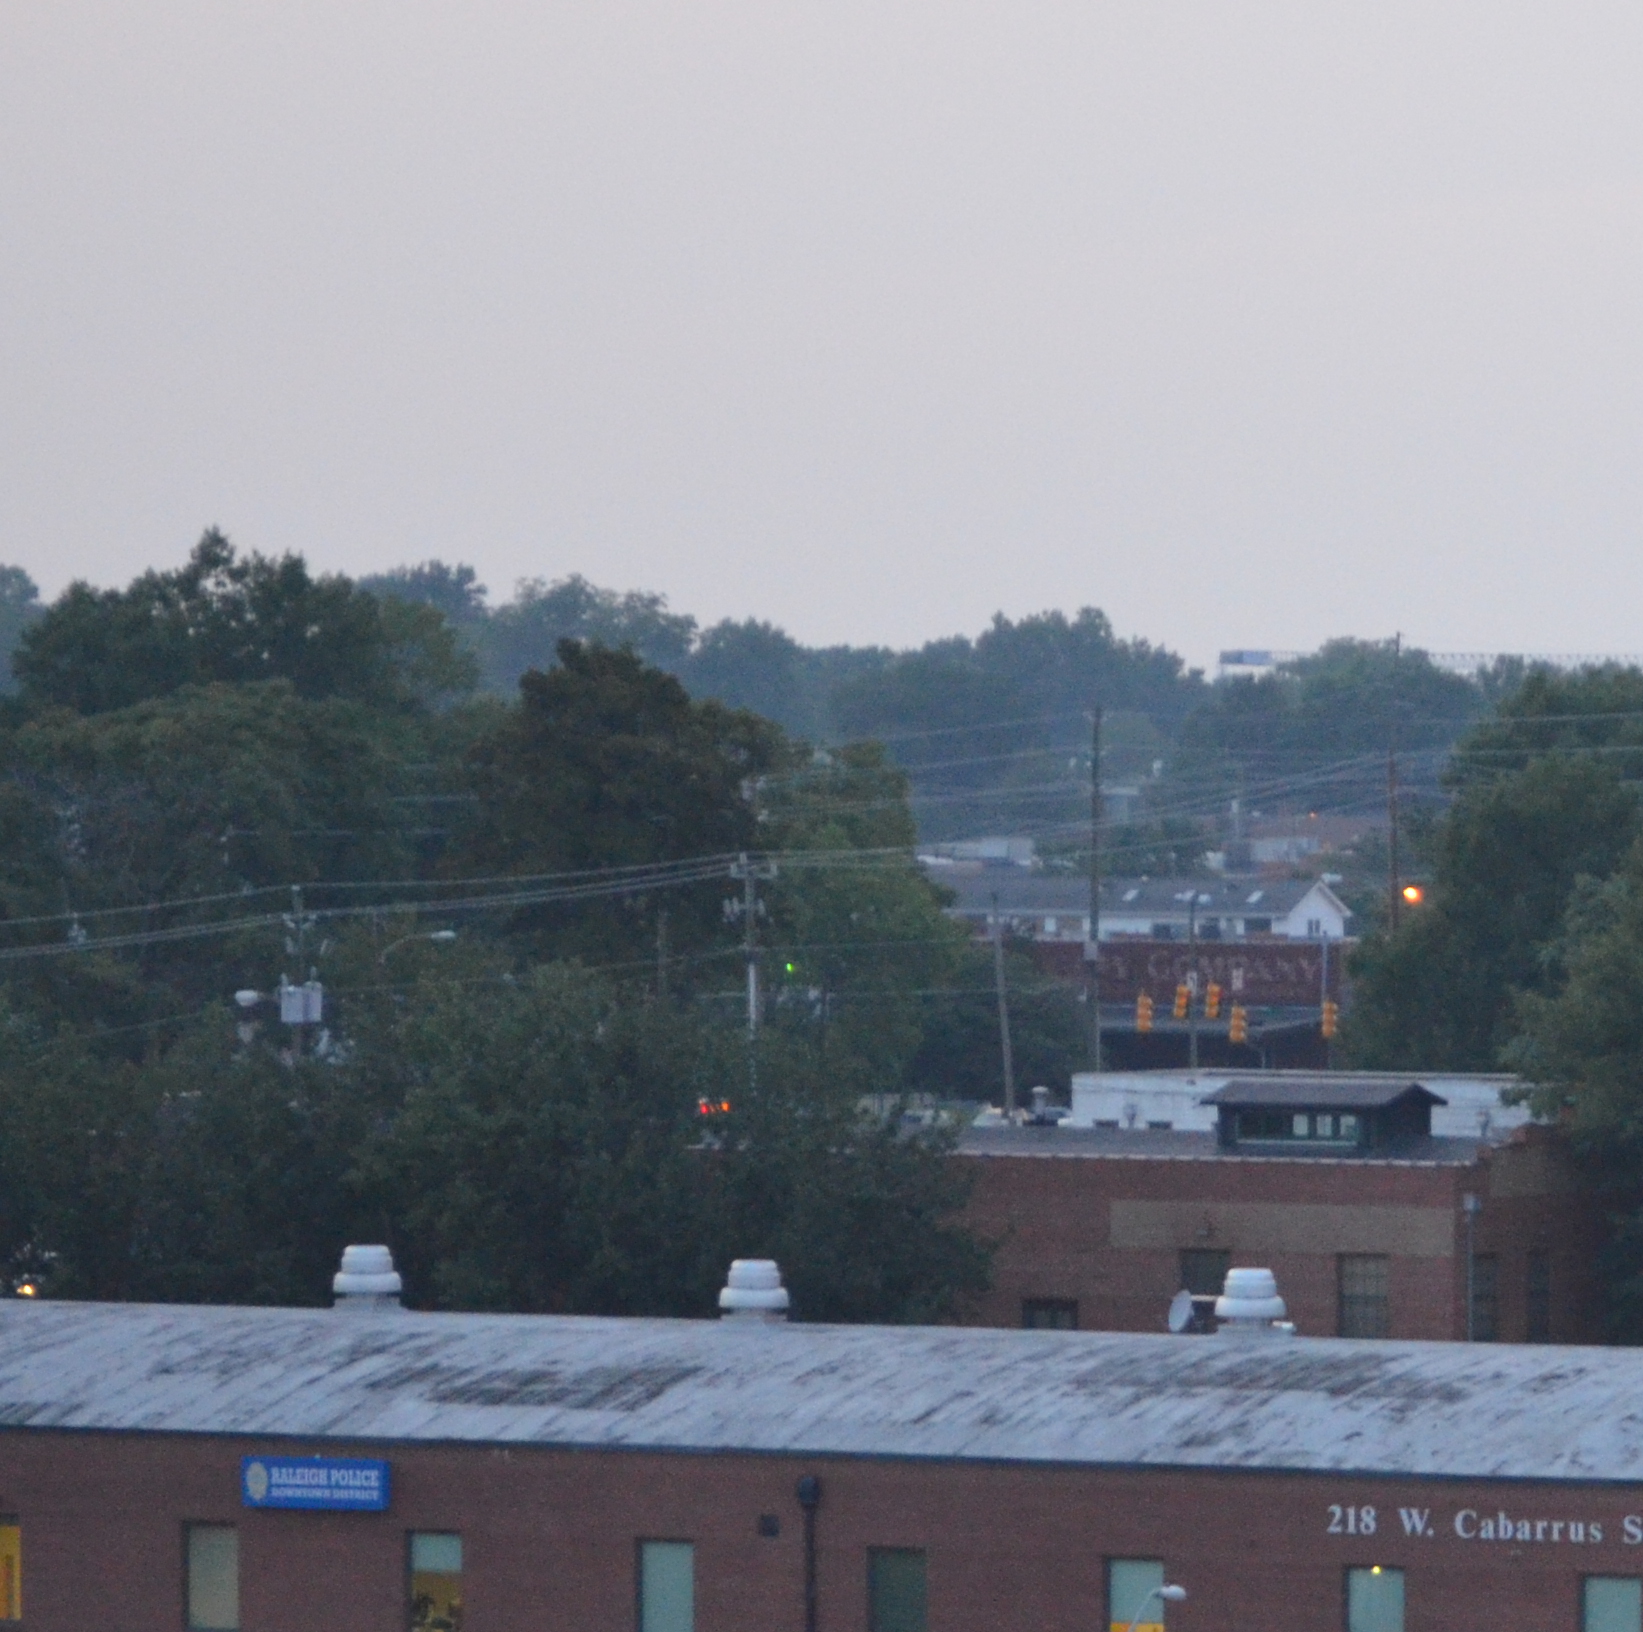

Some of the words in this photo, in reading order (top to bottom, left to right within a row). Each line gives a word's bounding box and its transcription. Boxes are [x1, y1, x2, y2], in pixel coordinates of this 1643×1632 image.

[271, 1467, 328, 1485] RALEIGH
[330, 1468, 379, 1487] POLICE
[271, 1487, 330, 1498] DOWNTOWN
[332, 1489, 379, 1501] DISTRICT
[1326, 1503, 1377, 1536] 218
[1399, 1507, 1434, 1538] W.
[1454, 1508, 1604, 1543] Cabarrus
